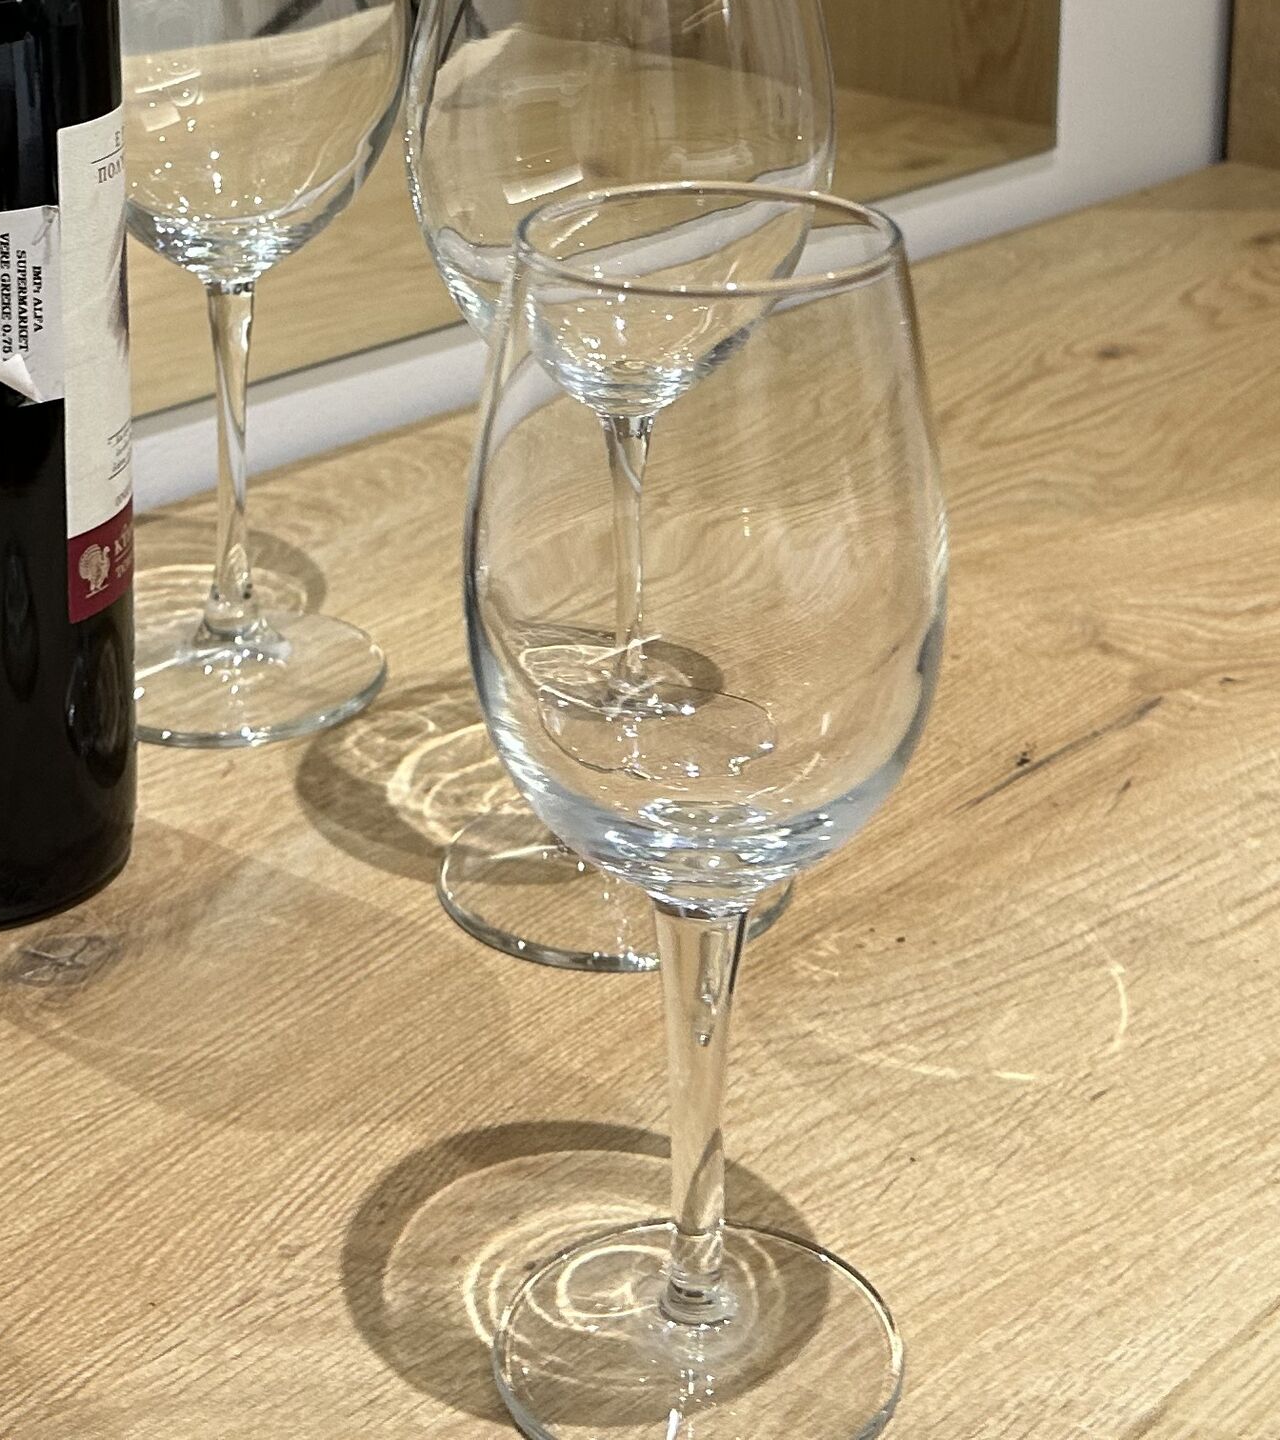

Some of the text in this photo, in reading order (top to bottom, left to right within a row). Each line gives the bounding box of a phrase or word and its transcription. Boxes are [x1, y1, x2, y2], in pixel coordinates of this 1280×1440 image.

[0, 273, 13, 321] GREKE
[15, 249, 30, 353] SUPERMARKET
[32, 265, 44, 333] IMP: ALFA
[1, 323, 13, 354] 0.75
